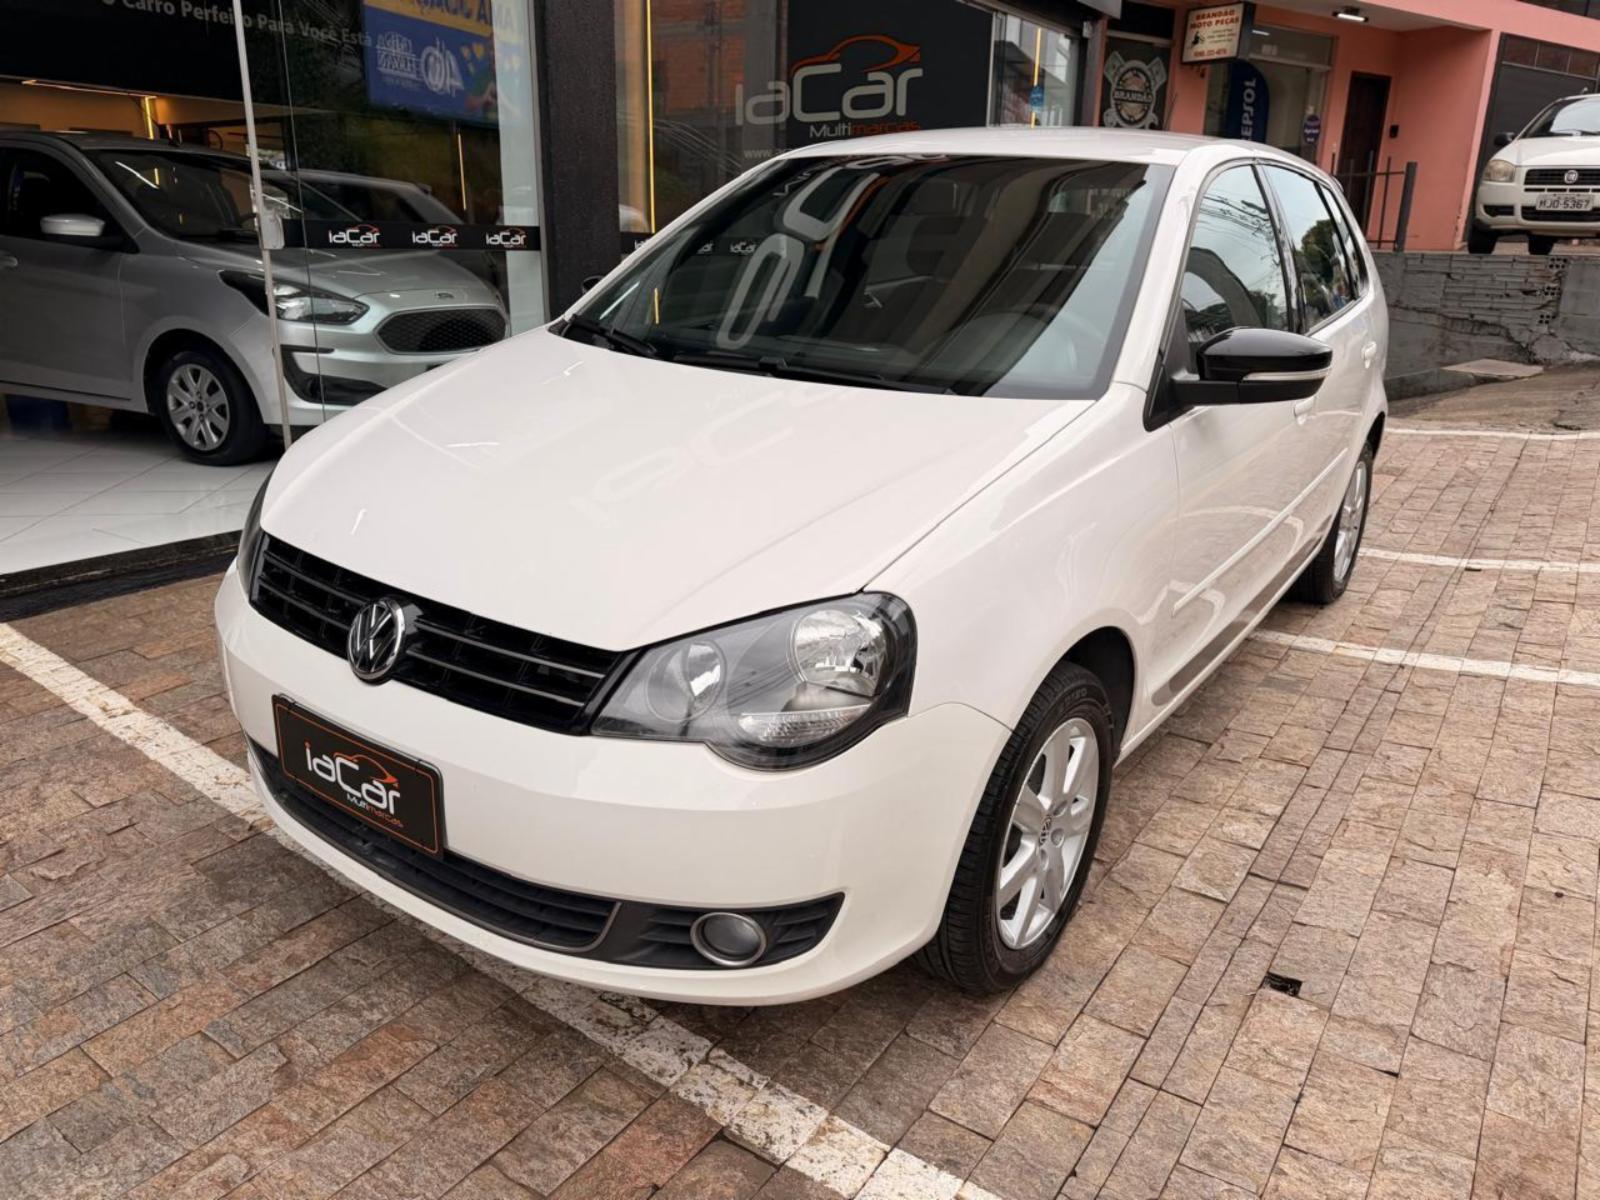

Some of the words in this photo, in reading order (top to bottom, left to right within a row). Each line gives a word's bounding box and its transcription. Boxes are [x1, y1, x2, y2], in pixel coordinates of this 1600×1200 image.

[180, 1, 251, 27] Perfeio
[257, 13, 294, 35] Para
[299, 21, 337, 39] Você
[1241, 78, 1256, 140] EPSOL
